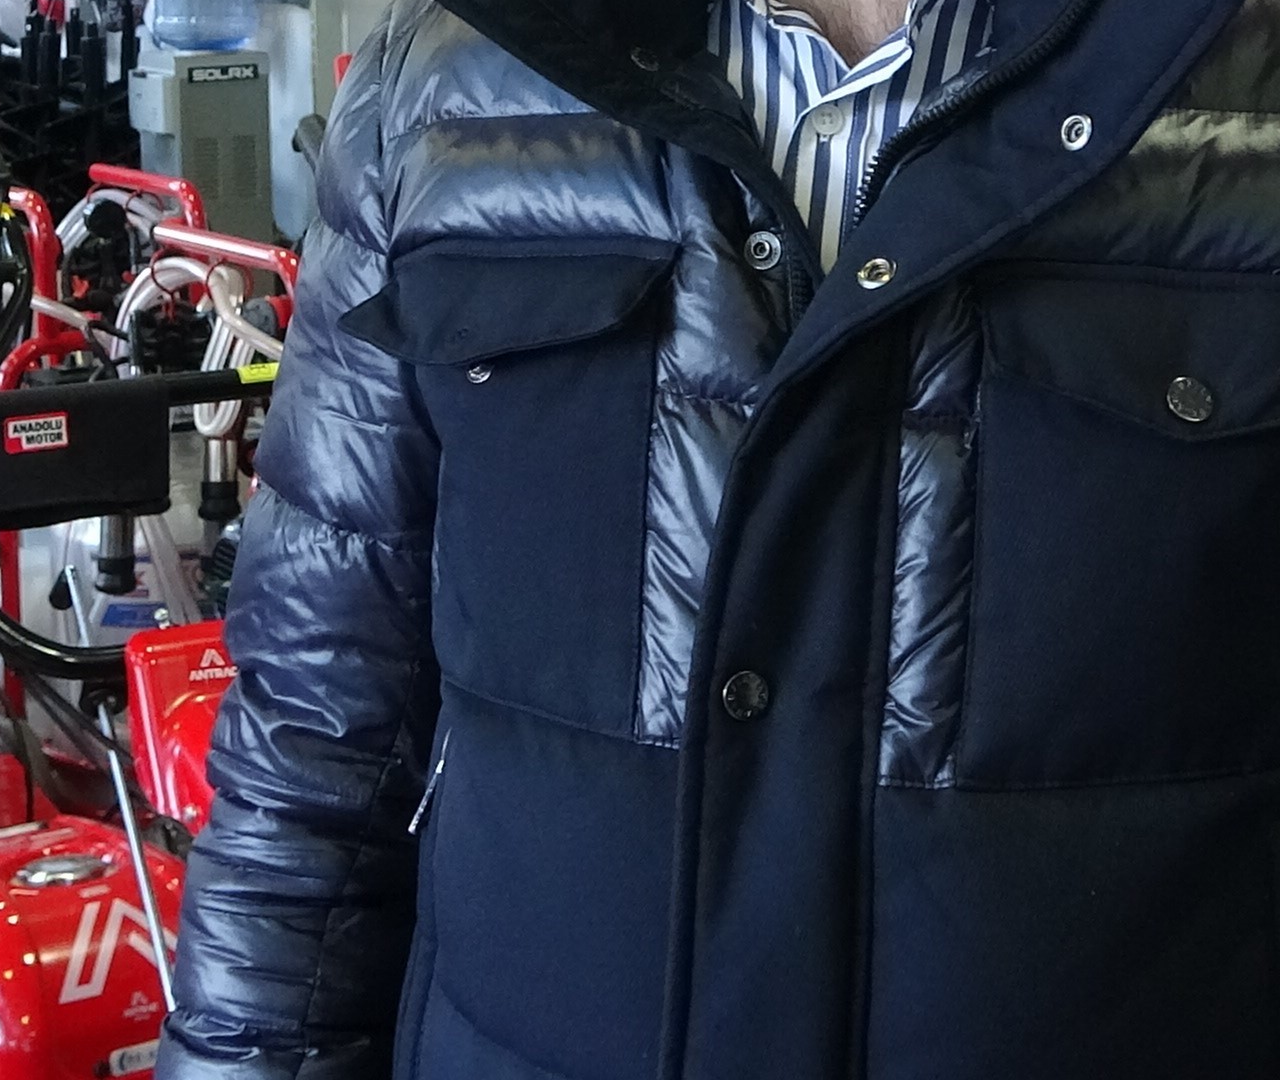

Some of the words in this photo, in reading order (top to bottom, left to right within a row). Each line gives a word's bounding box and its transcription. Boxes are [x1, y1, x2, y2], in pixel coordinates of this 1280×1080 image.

[192, 65, 254, 82] SOLAX
[12, 418, 63, 435] ANADOLU
[25, 431, 63, 445] MOTOR
